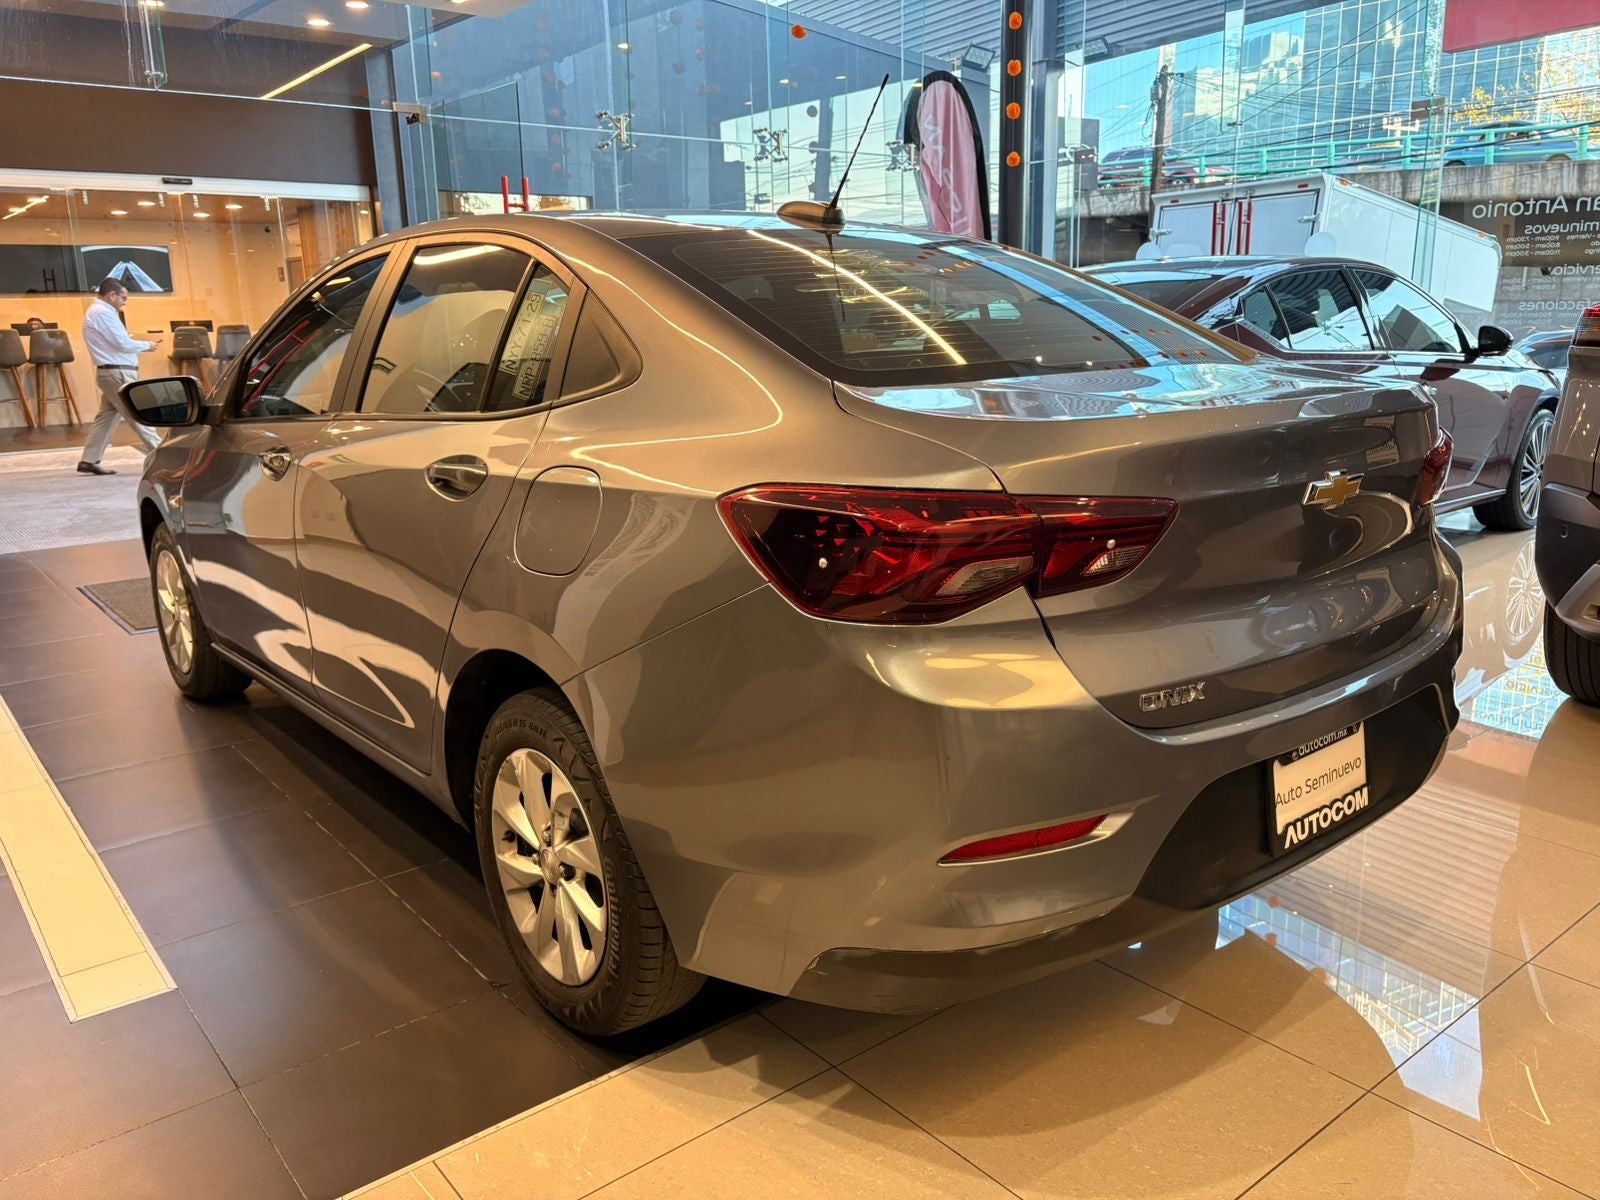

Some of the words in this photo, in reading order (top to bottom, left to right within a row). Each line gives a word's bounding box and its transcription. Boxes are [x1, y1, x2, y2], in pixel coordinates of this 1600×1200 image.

[505, 293, 542, 371] NYY-71-29
[1140, 682, 1206, 712] ONIX
[1298, 728, 1348, 756] autocom.mx
[1275, 784, 1303, 807] Auto
[1304, 756, 1362, 794] Seminuevo
[1284, 785, 1369, 849] AUTOCOM
